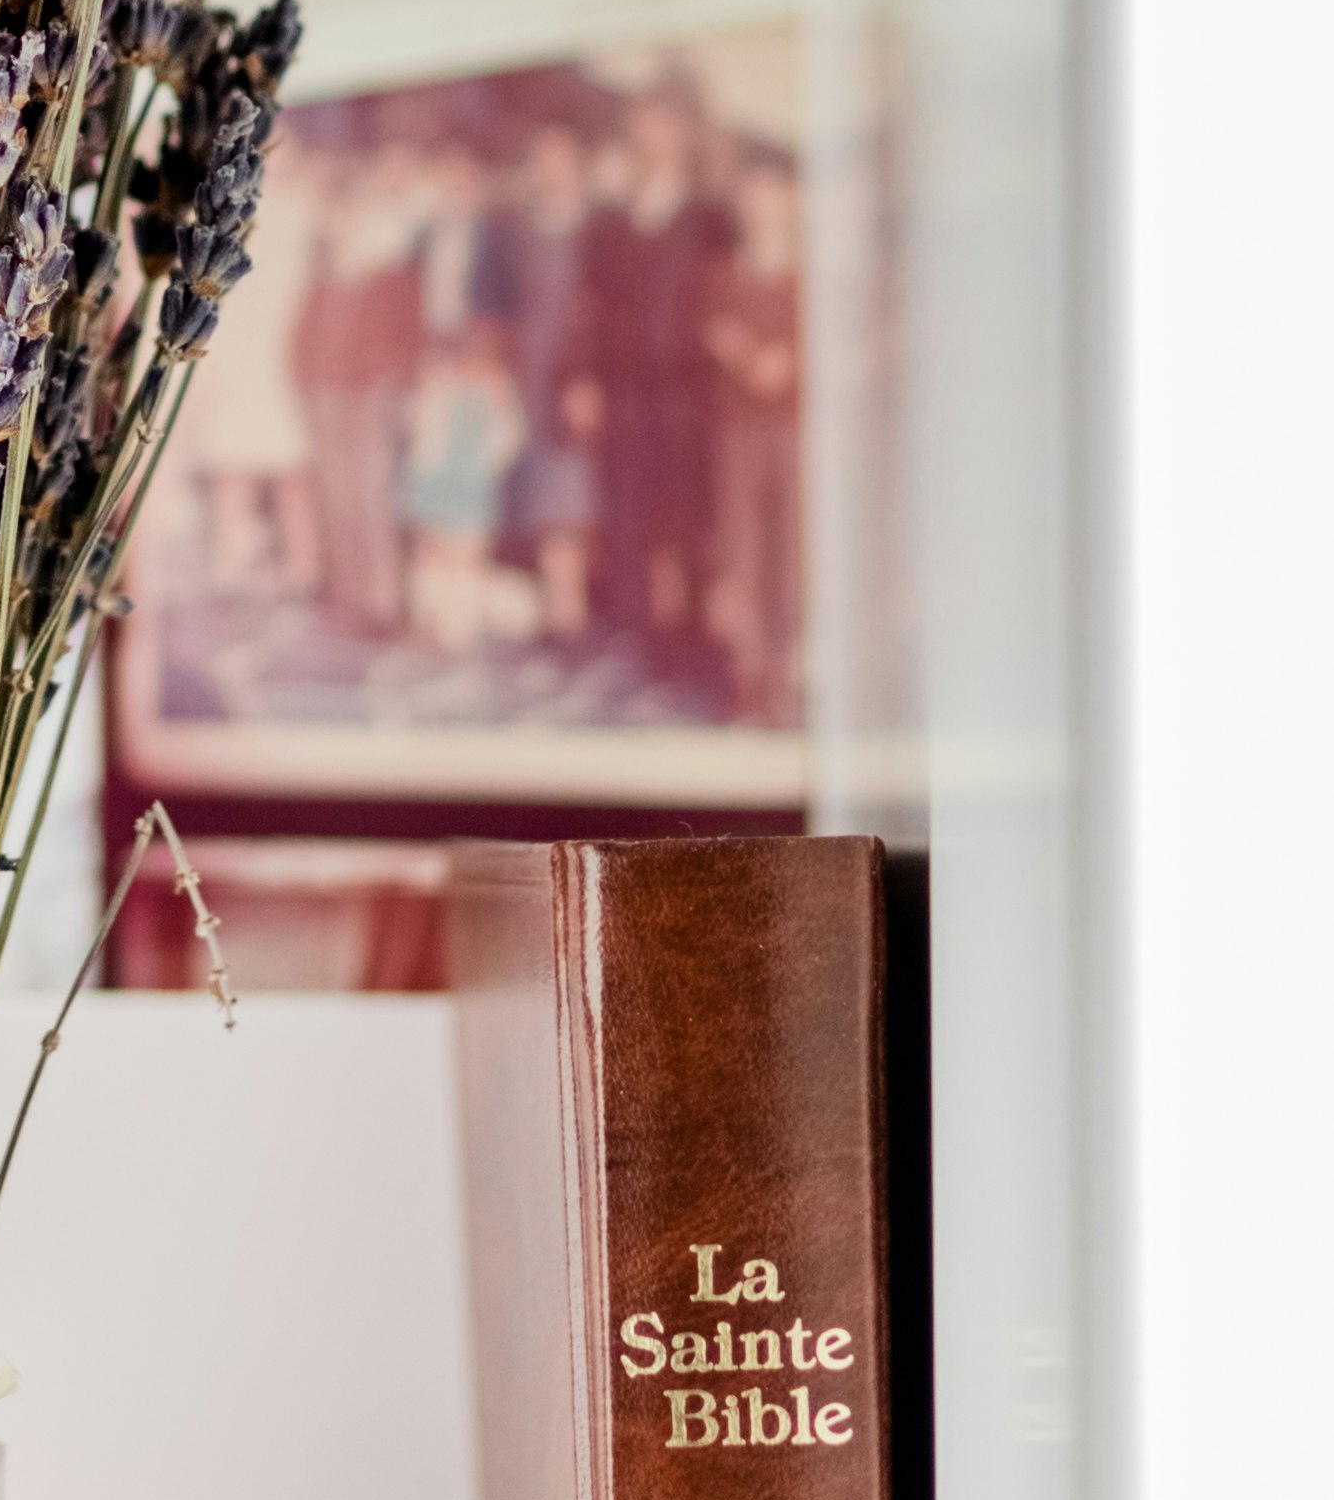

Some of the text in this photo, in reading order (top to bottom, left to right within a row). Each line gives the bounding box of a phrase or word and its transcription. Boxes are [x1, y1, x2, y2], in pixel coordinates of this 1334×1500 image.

[689, 1243, 785, 1305] La
[620, 1310, 854, 1378] Sainte
[663, 1385, 854, 1449] Bible
